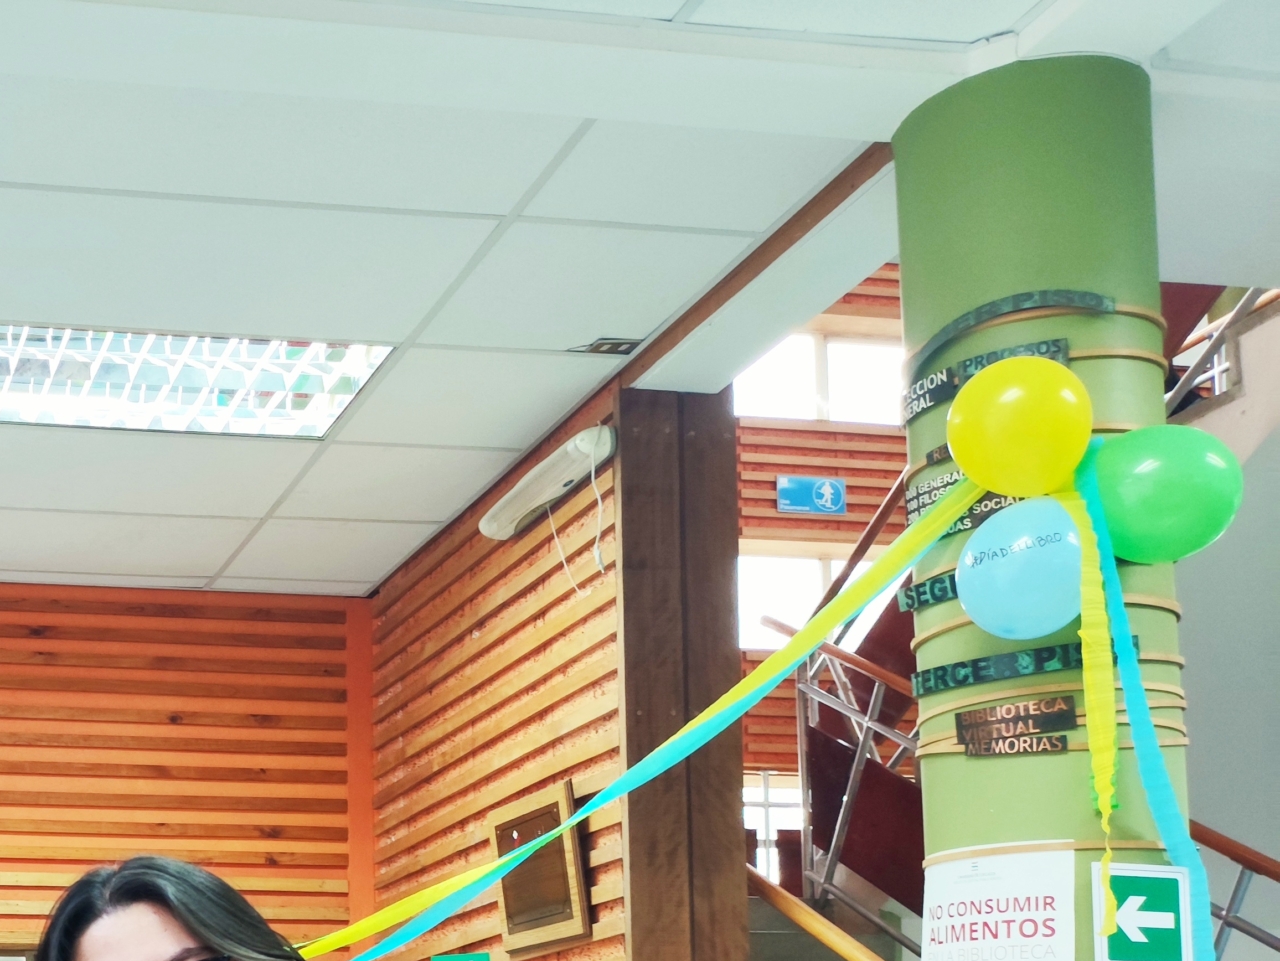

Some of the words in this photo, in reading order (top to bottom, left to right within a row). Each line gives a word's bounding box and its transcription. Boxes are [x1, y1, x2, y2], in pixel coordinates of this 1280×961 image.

[961, 698, 1068, 726] BIBLIOTECA
[962, 719, 1040, 743] VIRTUAL
[967, 736, 1063, 756] MEMORIAS
[928, 905, 943, 921] NO
[947, 895, 1056, 918] CONSUMIR
[928, 918, 1056, 947] ALIMENTOS
